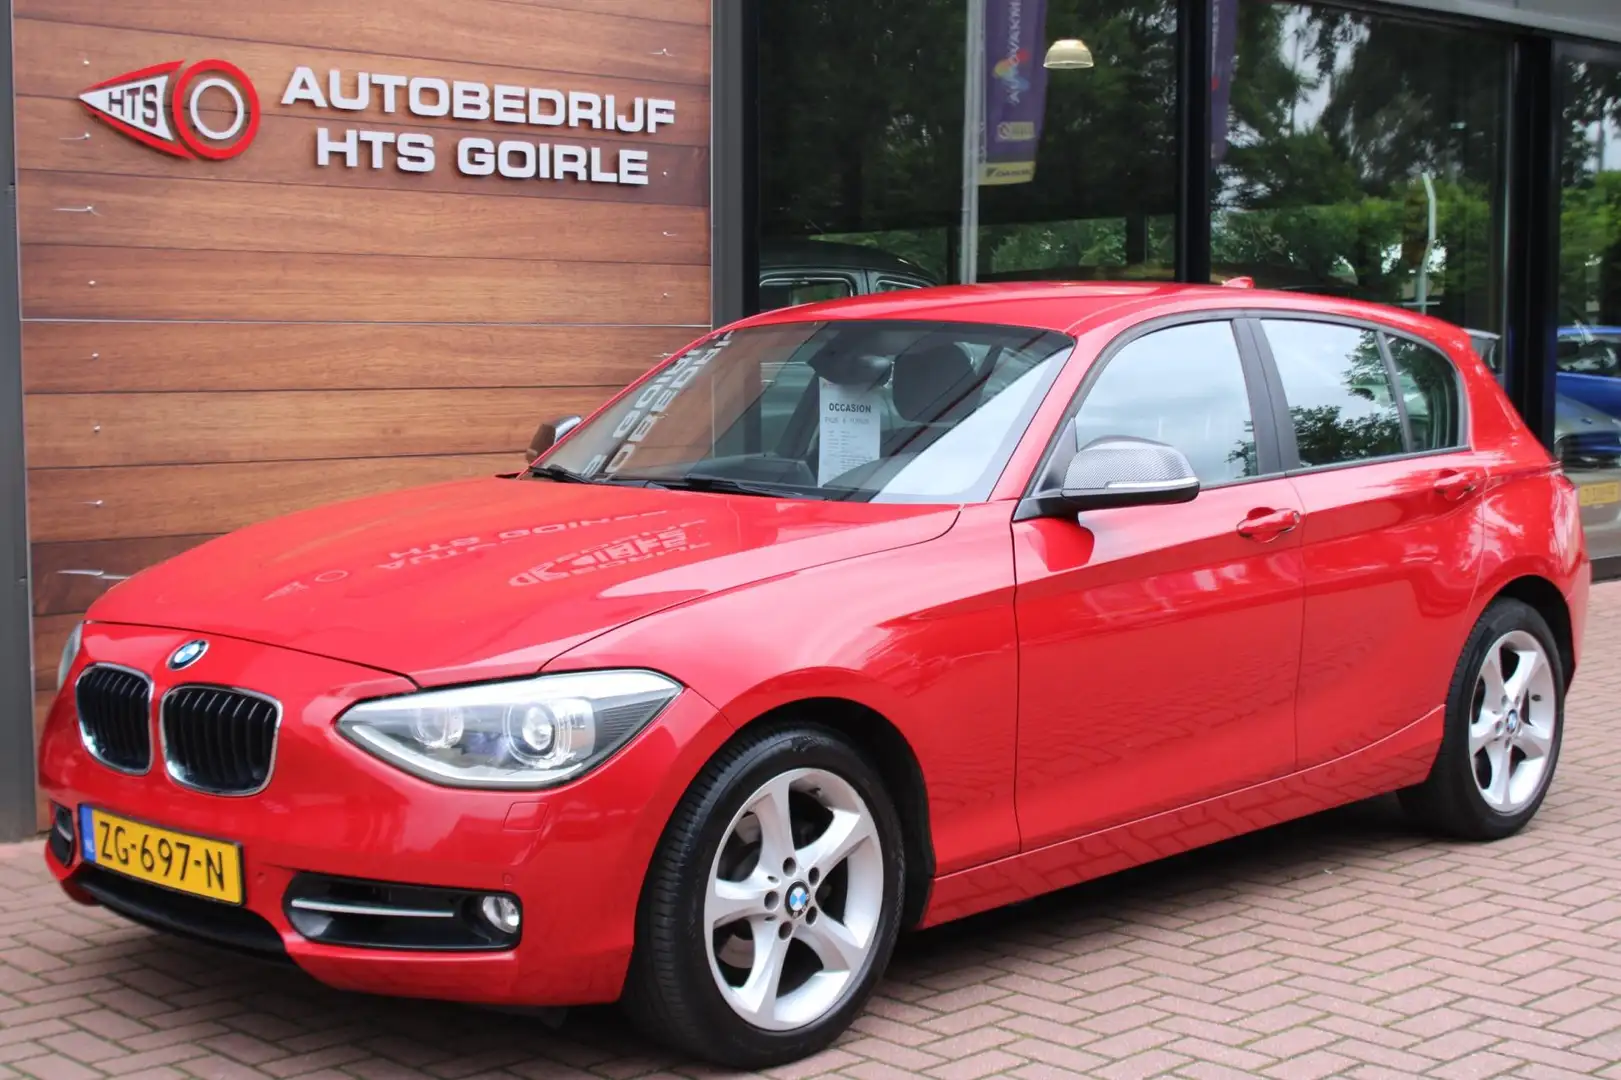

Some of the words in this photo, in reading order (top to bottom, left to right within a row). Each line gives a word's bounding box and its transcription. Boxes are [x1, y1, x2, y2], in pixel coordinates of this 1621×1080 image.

[108, 84, 158, 128] HTS
[281, 66, 676, 134] AUTOBEDRIJF
[316, 127, 436, 173] HTS
[457, 137, 649, 186] GOIRLE
[828, 402, 872, 413] OCCASION
[99, 820, 225, 892] ZG-697-N
